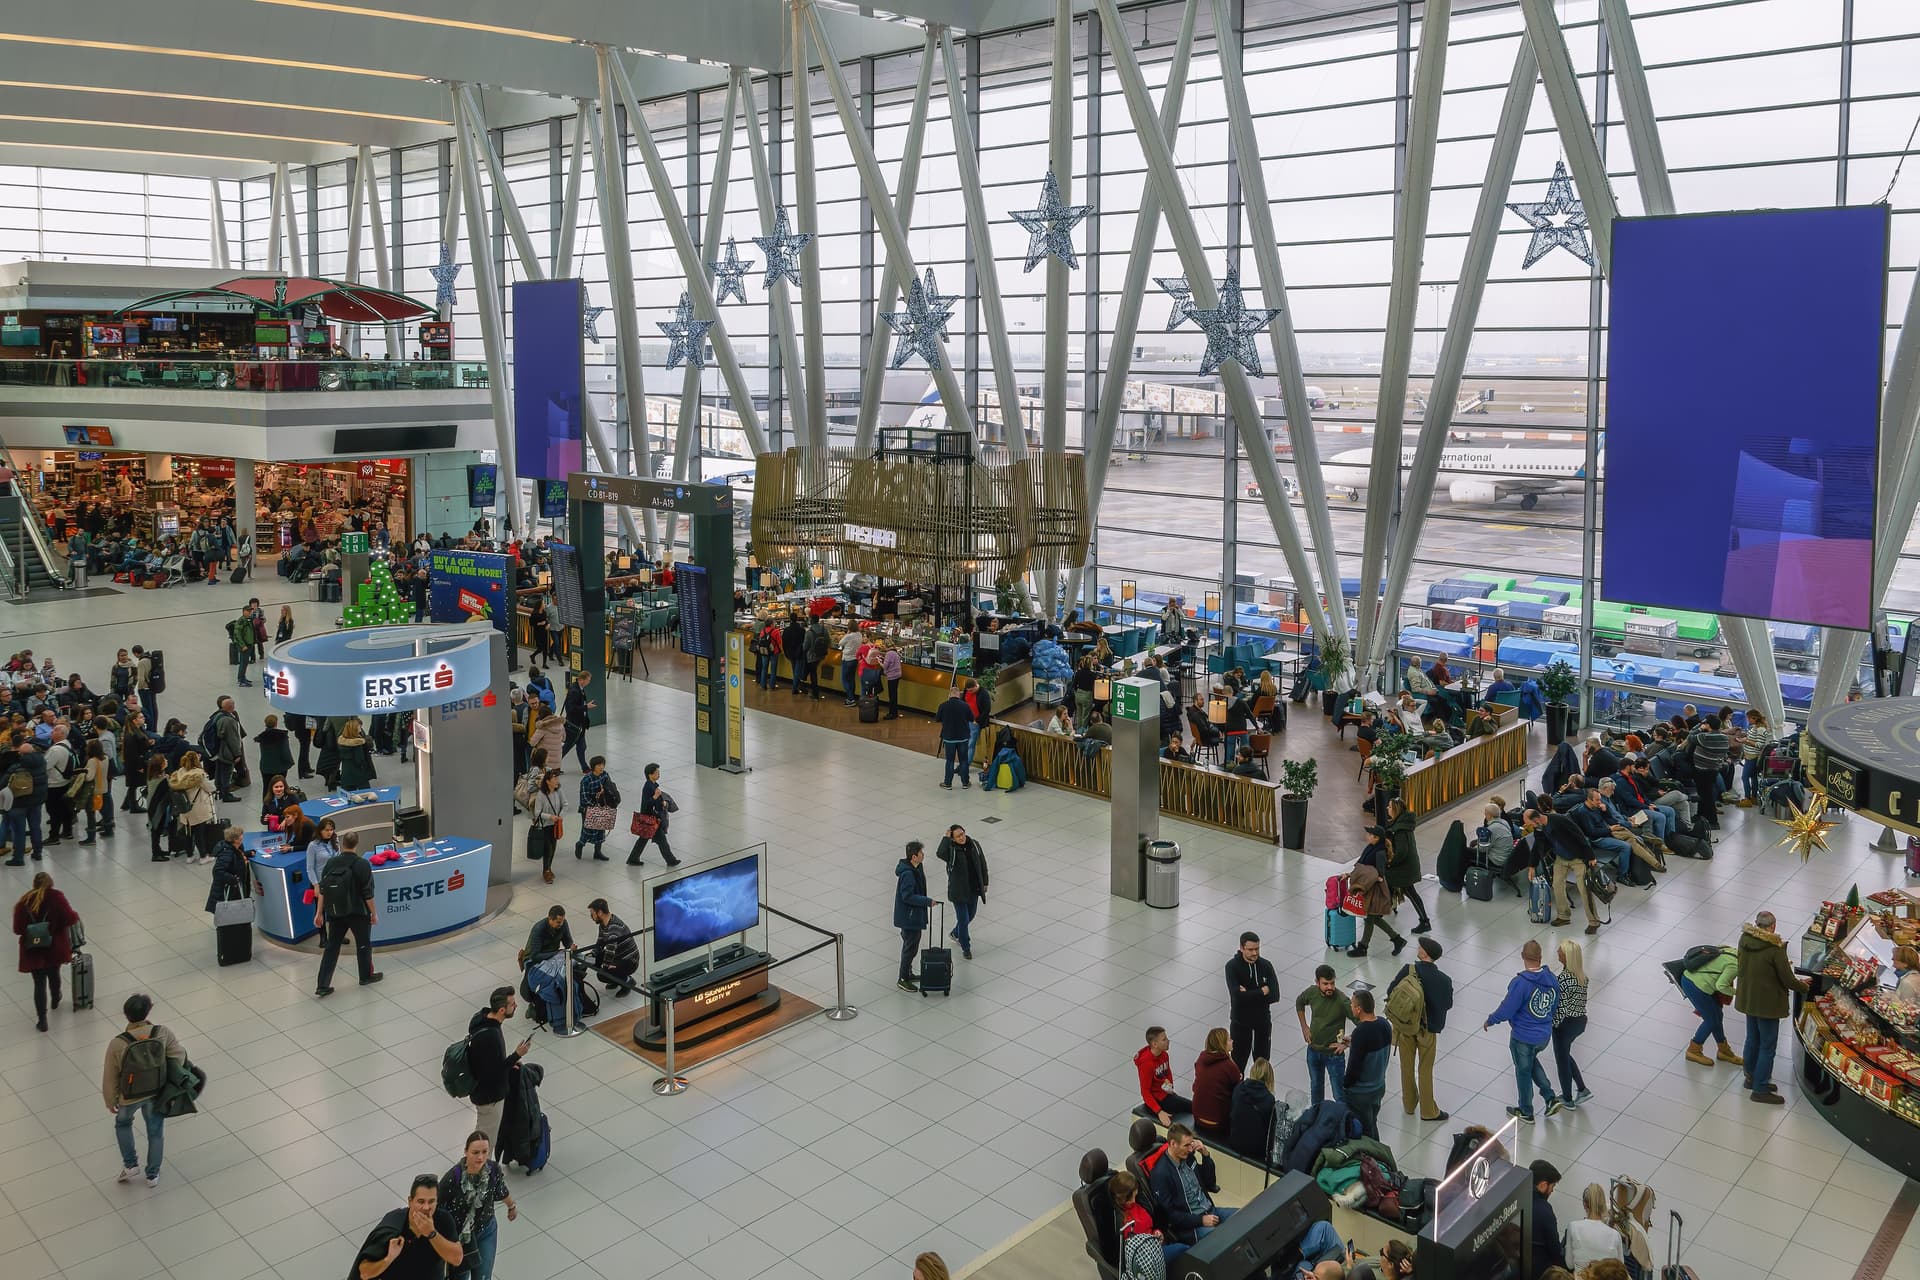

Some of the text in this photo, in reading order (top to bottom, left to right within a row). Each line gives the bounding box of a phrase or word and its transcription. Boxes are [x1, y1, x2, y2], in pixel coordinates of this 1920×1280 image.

[652, 497, 674, 508] A1-A19
[433, 555, 474, 567] BUY A GIFT
[445, 565, 460, 574] WIN
[461, 567, 476, 576] ONE
[478, 568, 503, 578] MORE!
[365, 673, 431, 696] ERSTE
[365, 698, 395, 709] Bank
[441, 697, 481, 713] ERSTE
[387, 880, 445, 903] ERSTE
[387, 904, 411, 913] Bank
[1346, 895, 1363, 909] FREE
[694, 993, 704, 1003] LG
[1473, 1200, 1519, 1252] Mercedes-Benz
